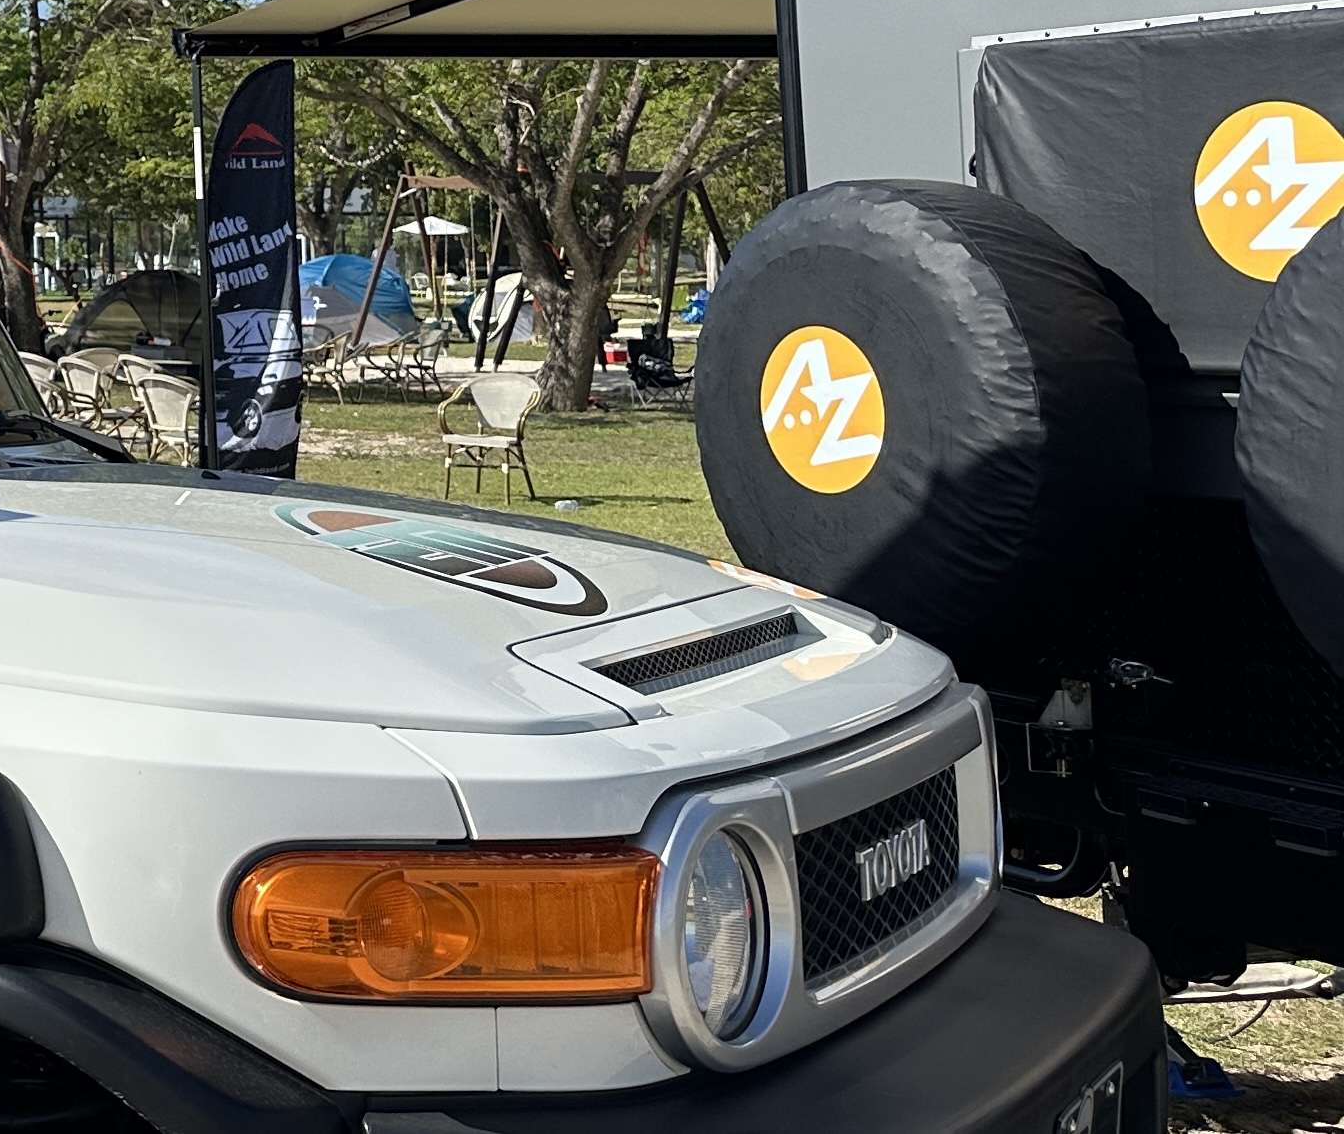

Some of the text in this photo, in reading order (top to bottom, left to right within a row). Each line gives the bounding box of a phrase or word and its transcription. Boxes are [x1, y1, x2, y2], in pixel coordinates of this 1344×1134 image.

[209, 237, 250, 268] Wild
[215, 262, 270, 292] Home
[855, 818, 931, 901] TOYOTA
